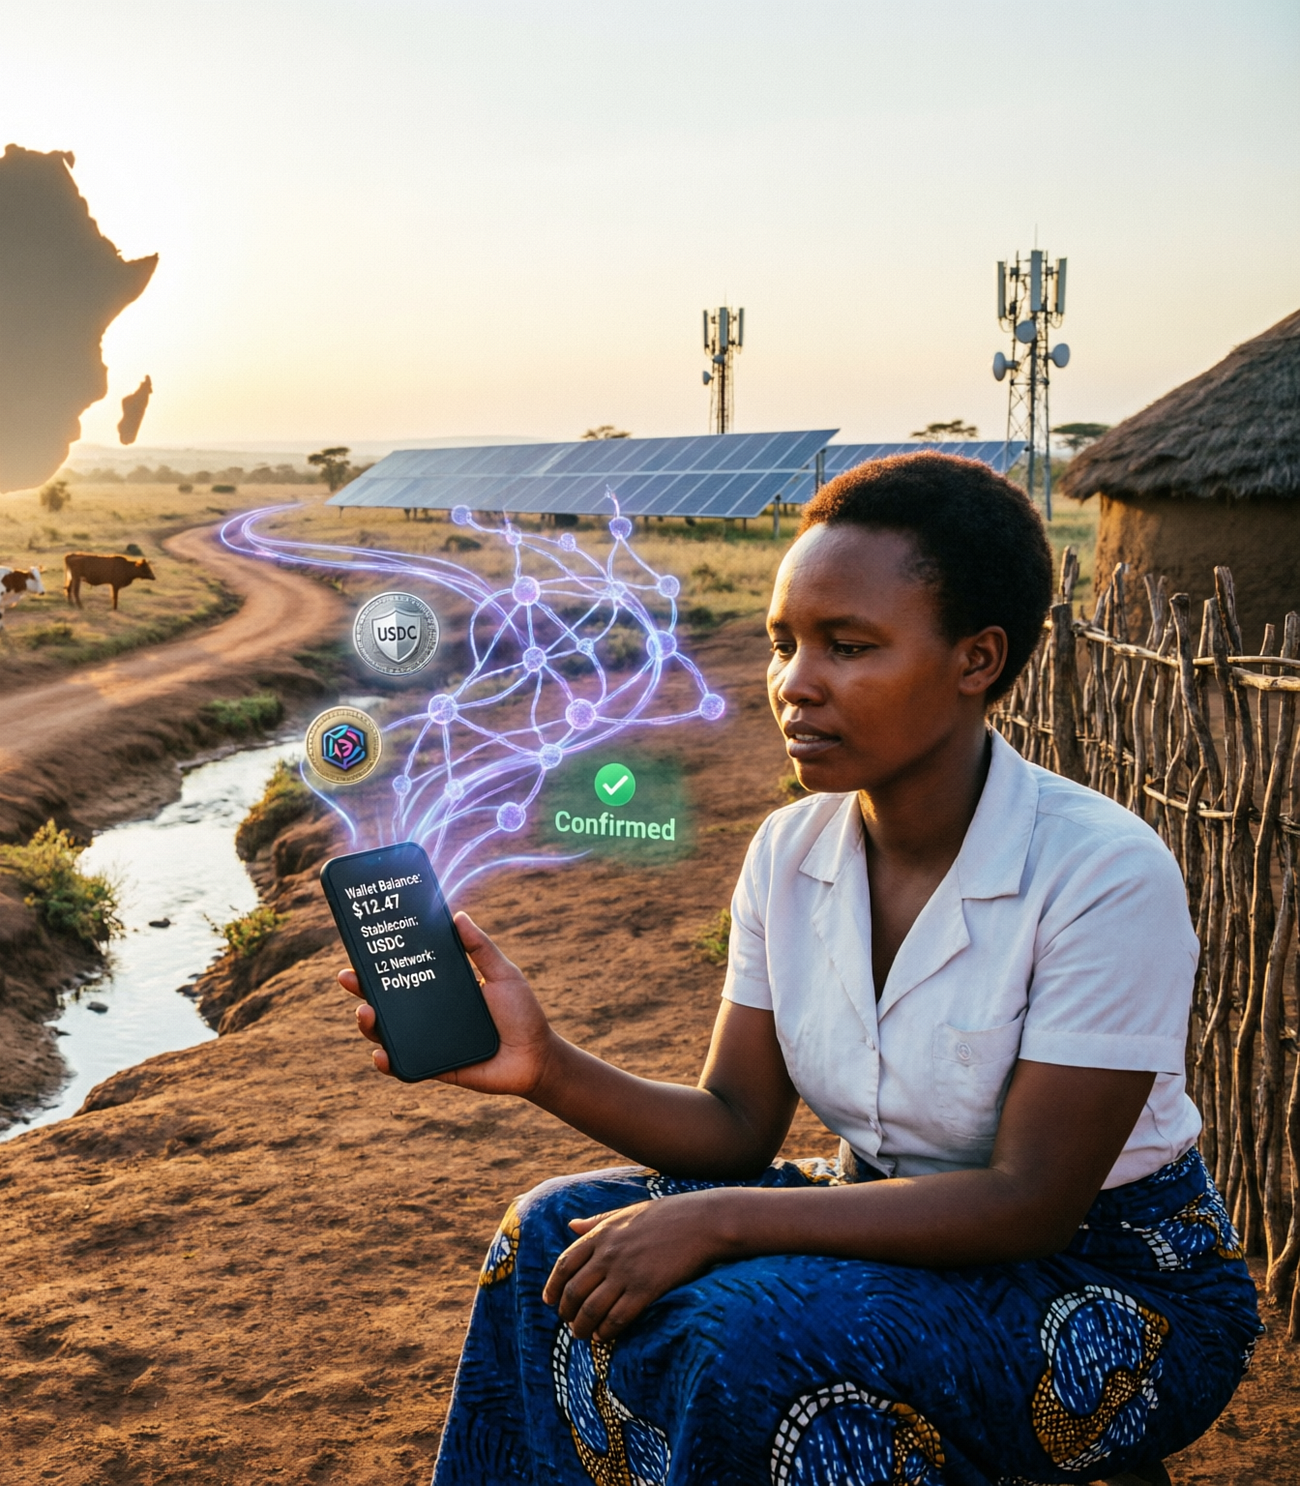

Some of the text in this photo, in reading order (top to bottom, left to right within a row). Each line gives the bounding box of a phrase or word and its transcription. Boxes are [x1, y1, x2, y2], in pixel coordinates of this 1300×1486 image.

[377, 625, 418, 642] USDC
[554, 810, 676, 841] Confirmed
[344, 873, 423, 900] Wallet Balance:
[351, 893, 400, 920] $12.47
[360, 915, 419, 938] Stablecoin:
[366, 934, 406, 954] USDC
[374, 949, 437, 974] L2 Network:
[380, 968, 437, 991] Polygon
